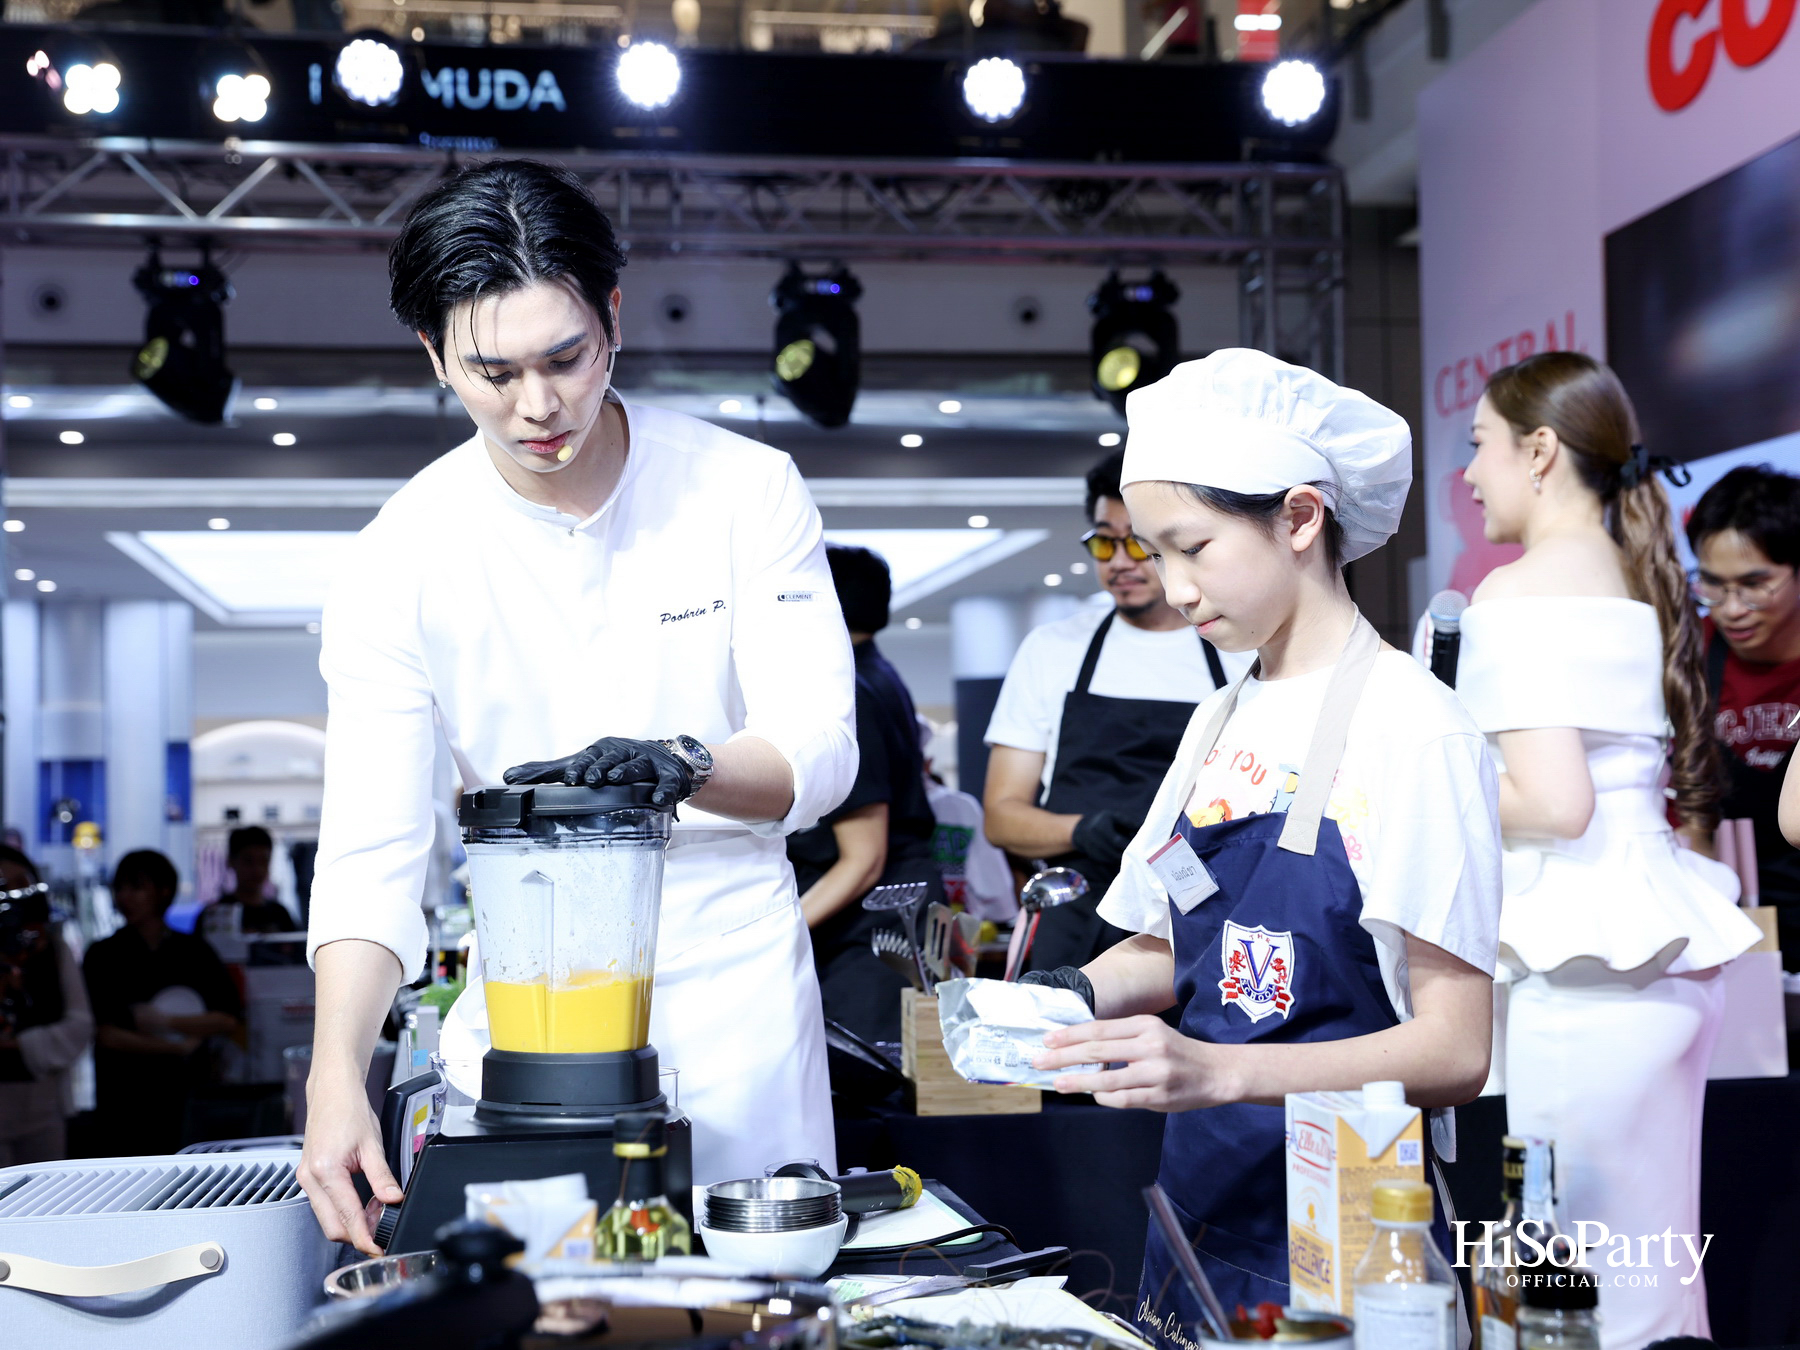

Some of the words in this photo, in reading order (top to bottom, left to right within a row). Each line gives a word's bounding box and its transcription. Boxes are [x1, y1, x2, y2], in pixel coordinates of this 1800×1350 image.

[660, 608, 707, 625] Poohrin
[712, 600, 726, 612] P.
[1229, 749, 1267, 785] YOU
[1164, 1312, 1202, 1350] Culinar
